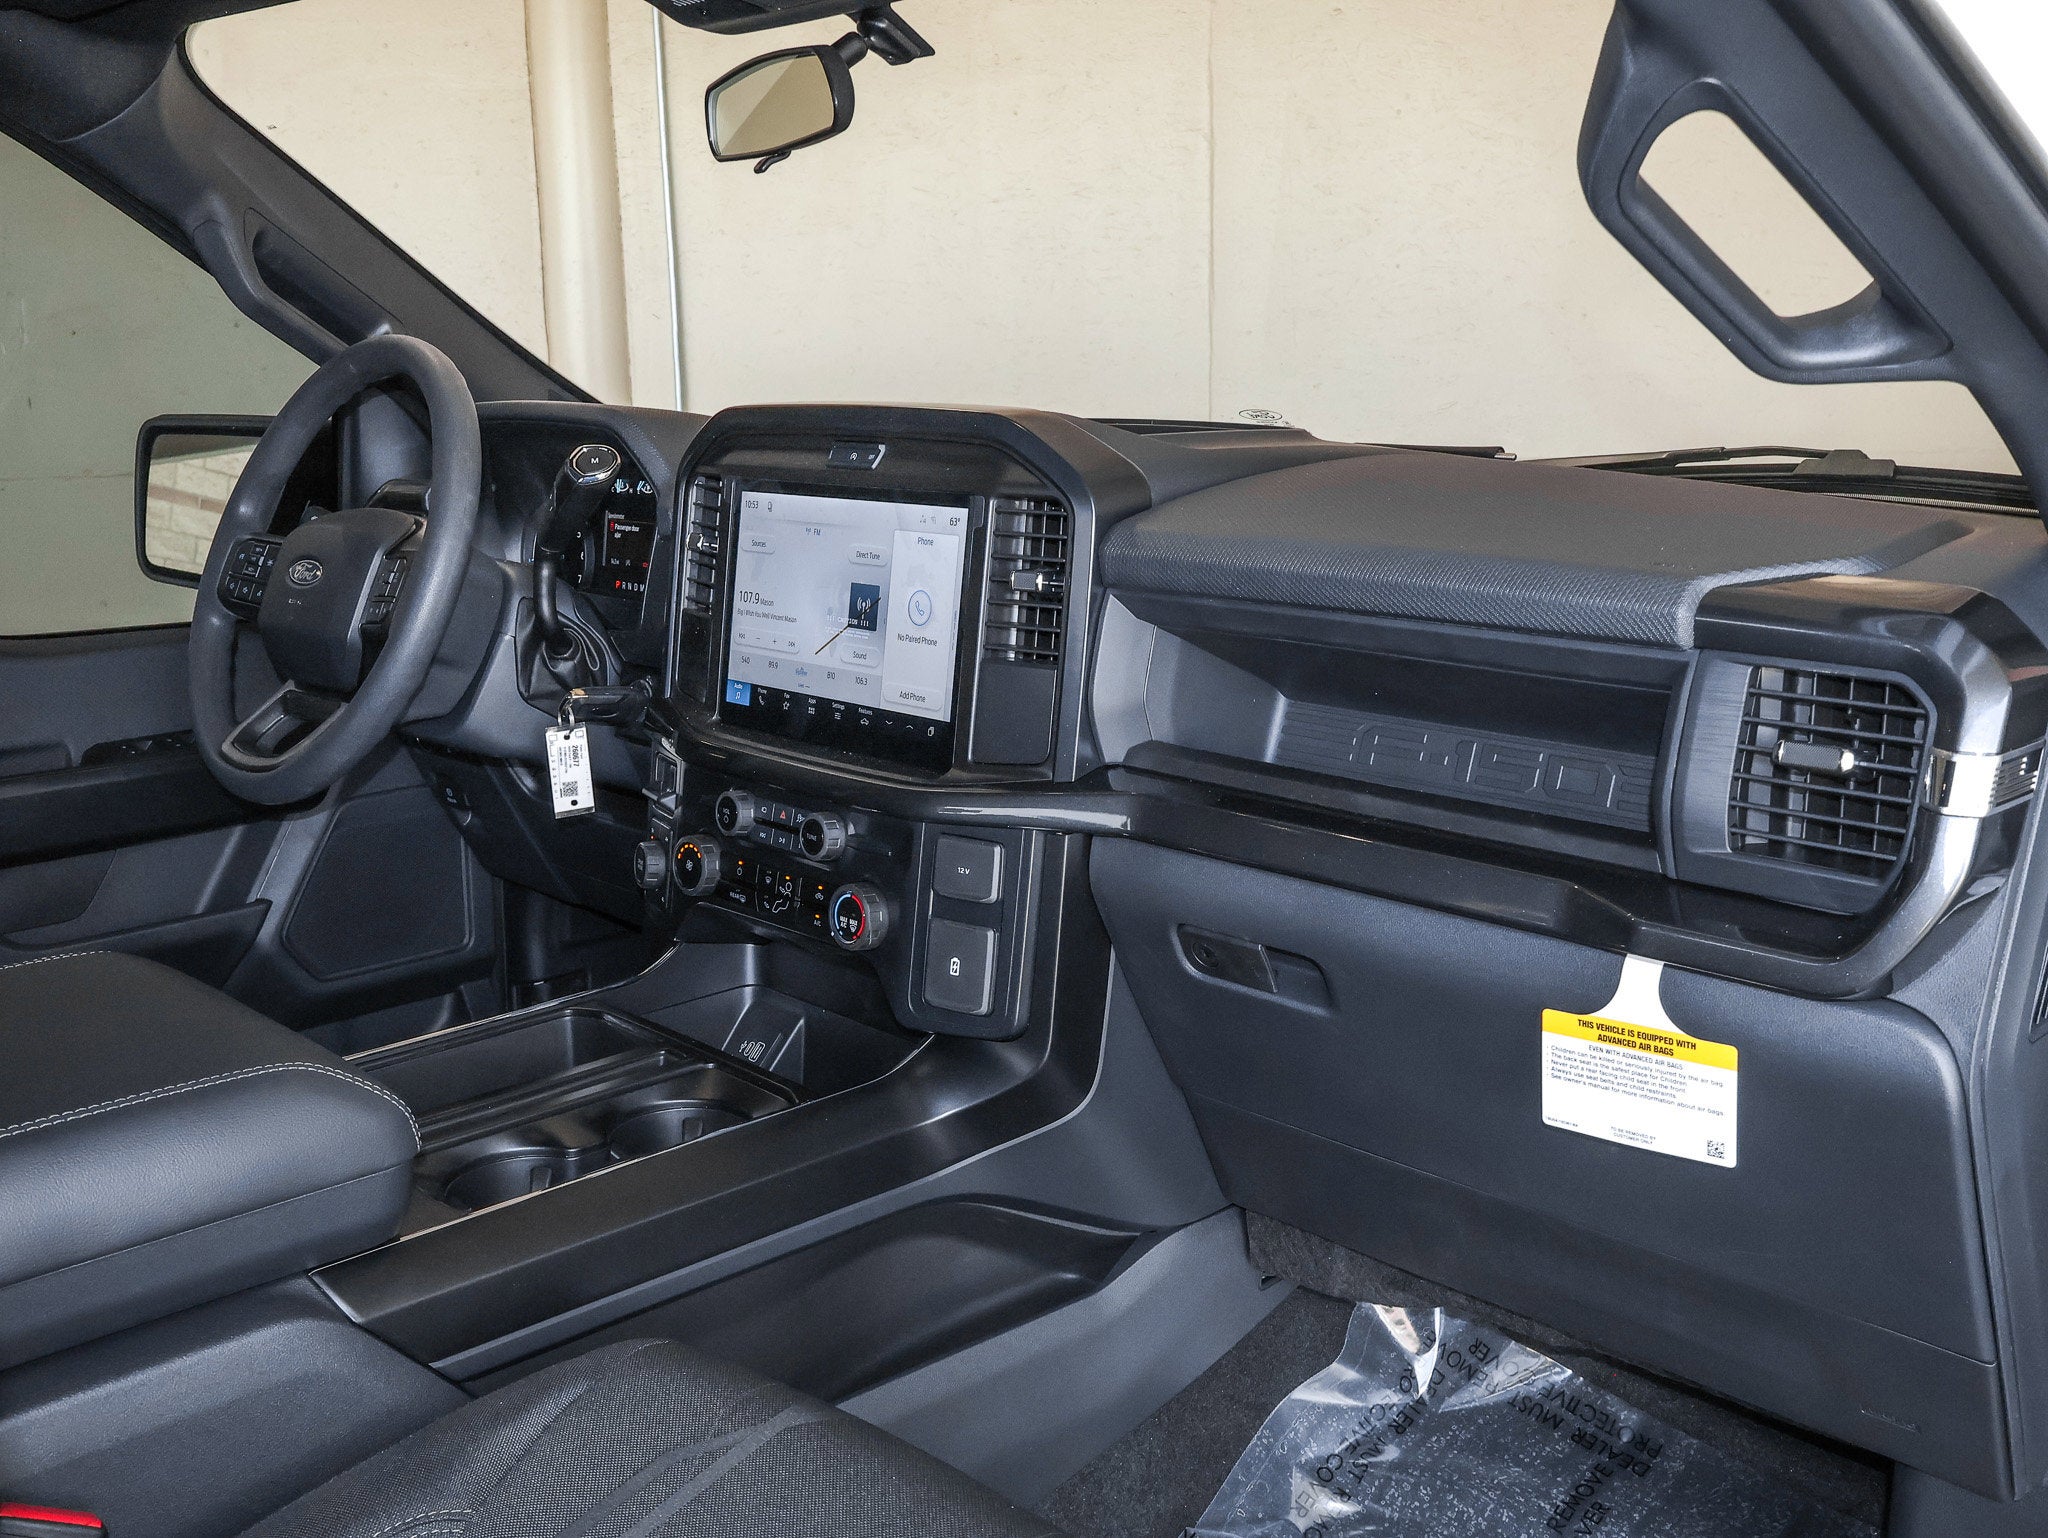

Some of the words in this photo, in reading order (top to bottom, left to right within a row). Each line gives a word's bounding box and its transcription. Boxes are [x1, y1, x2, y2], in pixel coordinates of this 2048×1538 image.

[745, 500, 759, 509] 10:53
[917, 536, 934, 546] Phone
[855, 550, 869, 559] Direct
[869, 551, 881, 560] Tune
[615, 580, 621, 589] P
[739, 590, 760, 605] 107.9
[897, 633, 905, 642] No
[905, 634, 921, 644] Paired
[921, 637, 938, 647] Phone
[852, 650, 867, 660] Sound
[899, 690, 910, 700] Add
[910, 692, 926, 703] Phone
[1577, 1018, 1594, 1029] THIS
[1595, 1022, 1626, 1036] VEHICLE
[1627, 1029, 1635, 1038] IS
[1637, 1031, 1674, 1046] EQUIPPED
[1675, 1039, 1697, 1050] WITH
[1597, 1033, 1637, 1048] ADVANCED
[1638, 1042, 1652, 1052] AIR
[1653, 1045, 1674, 1057] BAGS
[1550, 1044, 1576, 1055] Children
[1598, 1055, 1615, 1064] killed
[1625, 1062, 1653, 1073] seriously
[1654, 1067, 1677, 1077] injured
[1678, 1071, 1686, 1080] by
[1688, 1074, 1699, 1082] the
[1578, 1058, 1592, 1066] seat
[1611, 1066, 1630, 1074] safest
[1631, 1070, 1648, 1078] place
[1588, 1044, 1604, 1053] EVEN
[1605, 1048, 1621, 1056] WITH
[1621, 1052, 1653, 1064] ADVANCED
[1666, 1061, 1684, 1071] BAGS
[1550, 1066, 1572, 1076] Always
[1599, 1077, 1615, 1085] belts
[1629, 1084, 1645, 1092] child
[1551, 1059, 1568, 1067] Never
[1599, 1069, 1618, 1080] facing
[1619, 1075, 1635, 1083] child
[1636, 1078, 1650, 1086] seat
[1658, 1082, 1669, 1090] the
[1587, 1082, 1610, 1091] manual
[1621, 1089, 1638, 1098] more
[1638, 1093, 1676, 1105] information
[1676, 1102, 1696, 1110] about
[1387, 1366, 1447, 1436] DEALER
[1506, 1390, 1566, 1430] MUST
[1538, 1382, 1664, 1459] PROTECTIVE
[1349, 1435, 1391, 1484] MUST
[1570, 1426, 1651, 1478] DEALER
[1546, 1463, 1614, 1535] REMOVE
